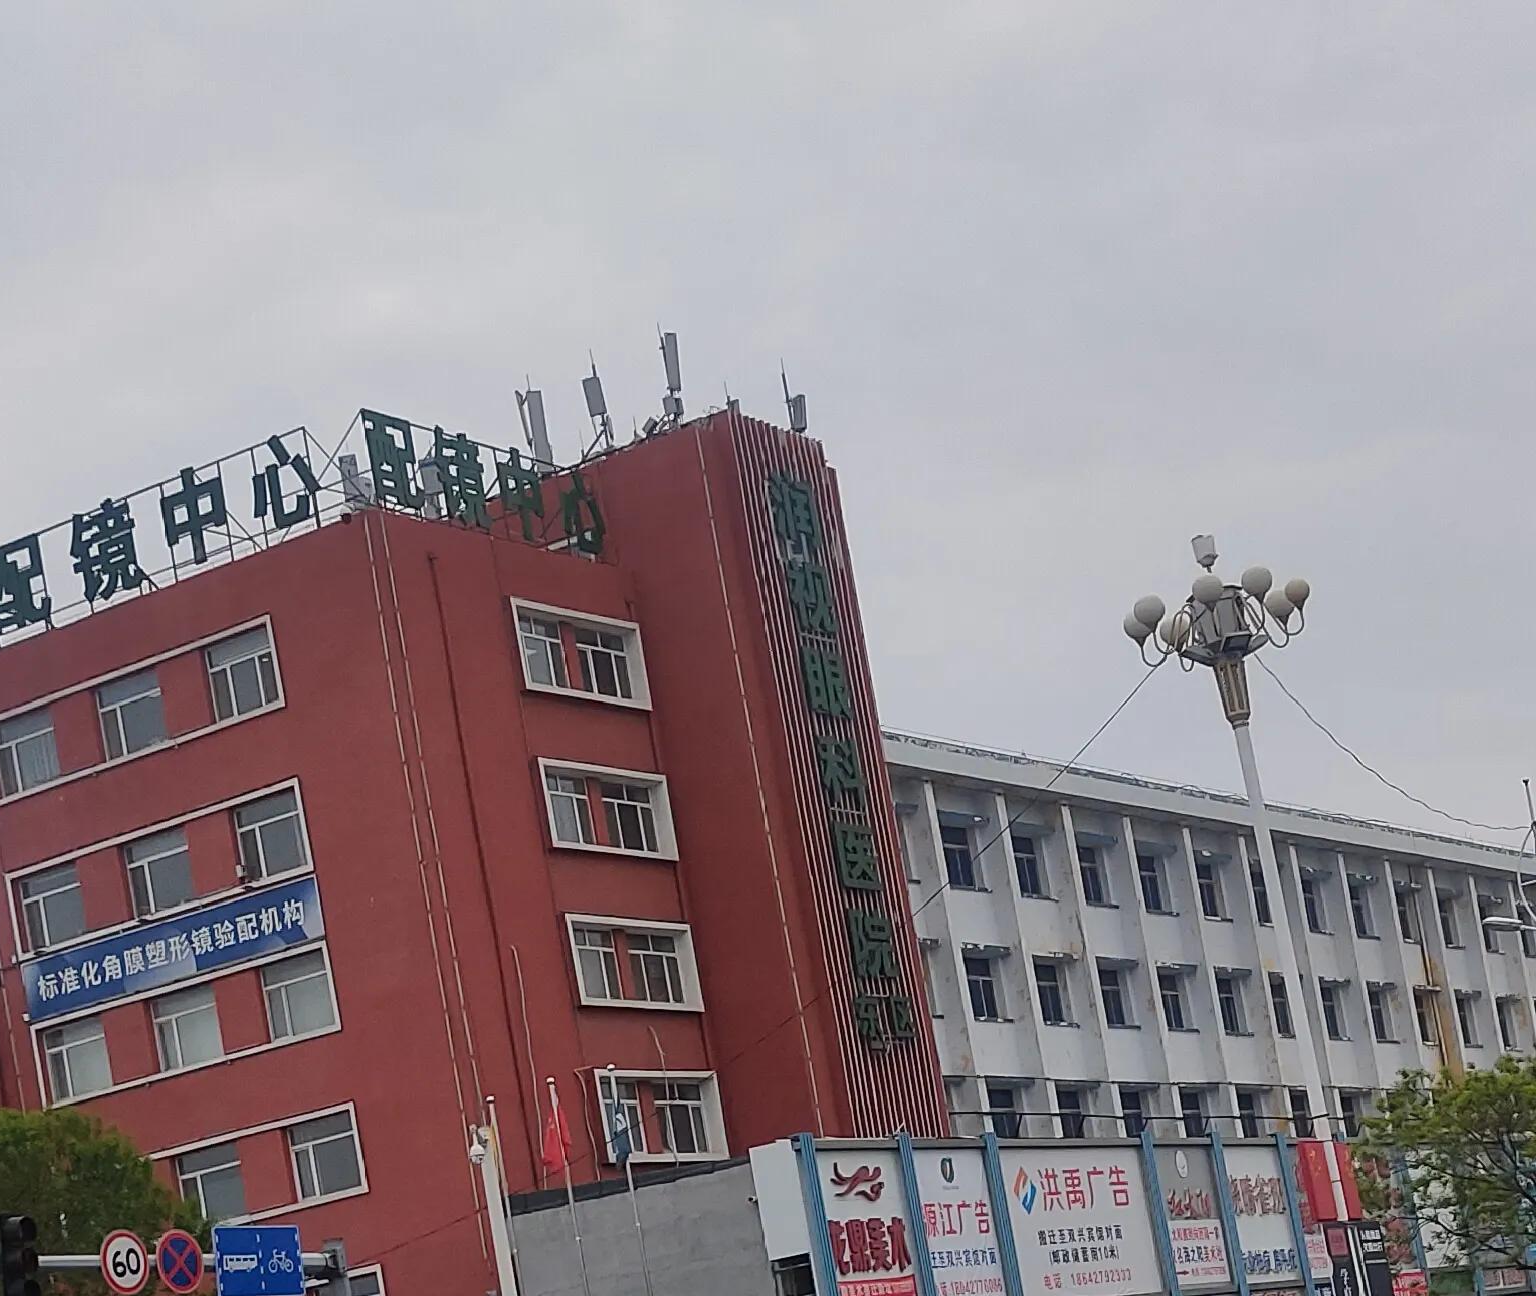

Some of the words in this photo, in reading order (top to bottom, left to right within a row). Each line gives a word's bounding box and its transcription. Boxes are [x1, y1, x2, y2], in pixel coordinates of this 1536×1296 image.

[364, 408, 605, 555] 配镜中心
[37, 898, 306, 1002] 标准化角膜塑形镜验配机构
[1037, 1164, 1130, 1212] 洪禹广告
[111, 1247, 141, 1275] 60
